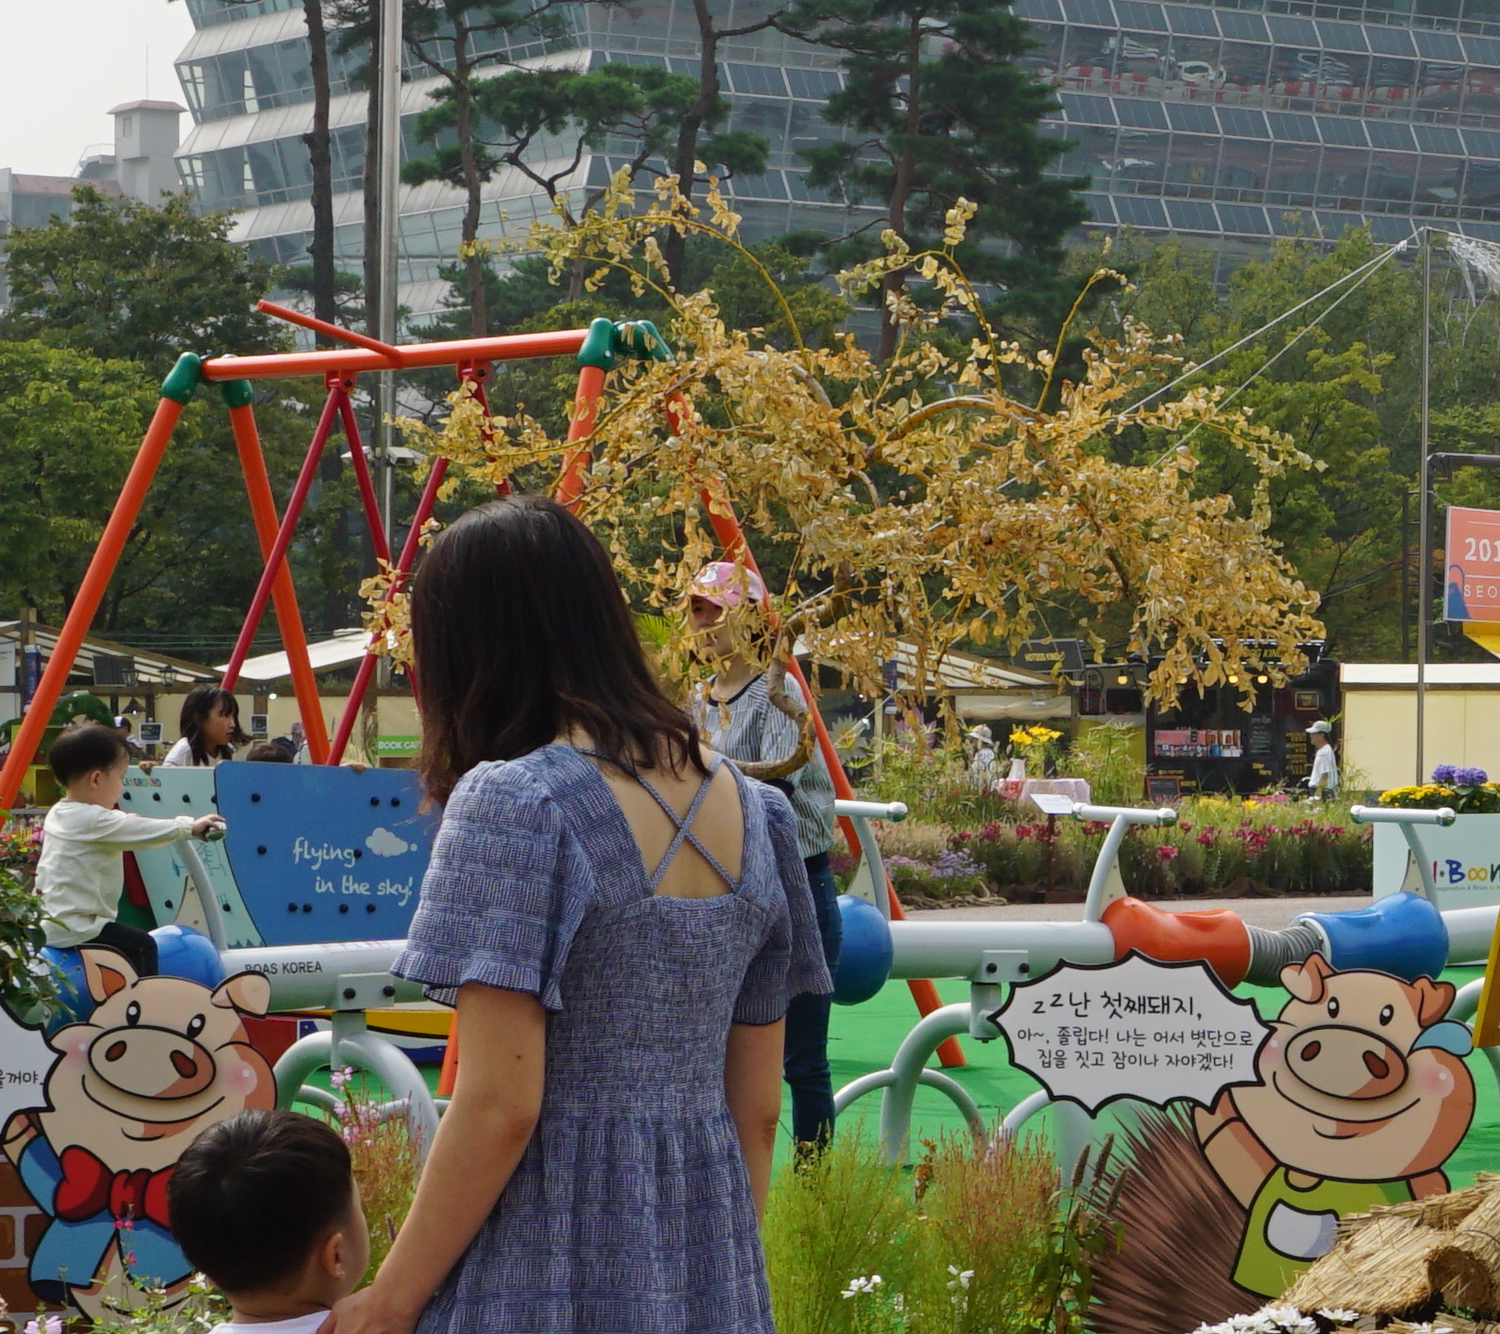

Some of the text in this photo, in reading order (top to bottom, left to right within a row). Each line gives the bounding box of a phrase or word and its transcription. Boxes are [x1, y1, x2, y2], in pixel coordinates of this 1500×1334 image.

[293, 837, 357, 870] flying
[315, 875, 413, 907] in the sky!
[282, 961, 323, 974] KOREA
[1102, 991, 1203, 1021] 첫째돼지,
[1056, 1026, 1109, 1047] 졸립다!
[1116, 1028, 1147, 1047] 나는
[1153, 1030, 1185, 1046] 어서
[1190, 1029, 1254, 1049] 볏단으로
[1037, 1049, 1234, 1072] 집을 짓고 잠이나 자야겠다!
